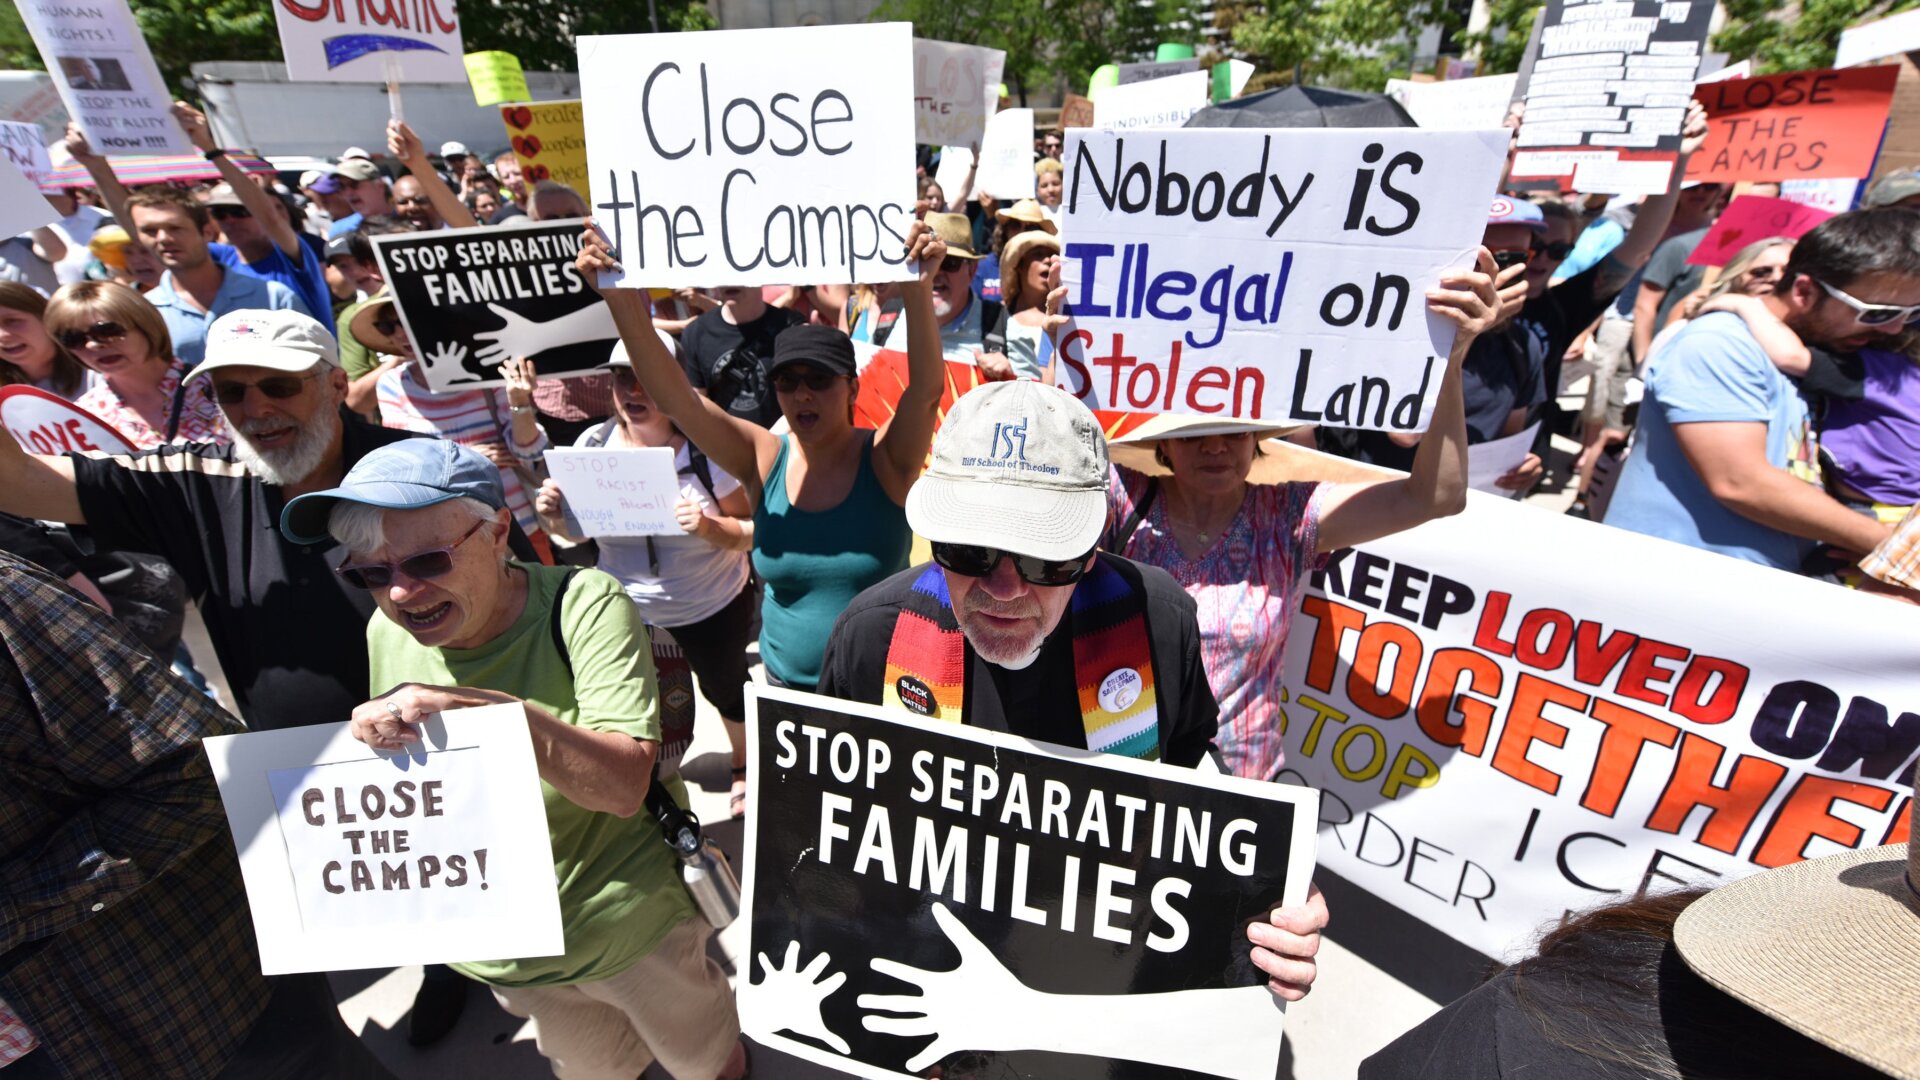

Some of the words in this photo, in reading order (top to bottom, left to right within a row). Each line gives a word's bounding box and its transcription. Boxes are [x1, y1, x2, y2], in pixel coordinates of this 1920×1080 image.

[38, 7, 104, 19] HUMAN
[47, 28, 104, 41] RIGHTS
[76, 94, 112, 109] STOP
[117, 97, 153, 109] THE
[1703, 74, 1840, 111] LOSE
[642, 61, 853, 160] Close
[914, 96, 953, 115] THE
[83, 116, 167, 129] BRUTALITY
[1113, 107, 1198, 129] INDIVISIBLE
[1721, 116, 1803, 144] THE
[101, 136, 141, 148] NOW
[522, 136, 586, 155] Acceptin
[1068, 135, 1316, 238] Nobody
[597, 168, 708, 270] the
[720, 168, 908, 283] Camps
[390, 244, 449, 273] STOP
[423, 261, 584, 307] FAMILIES
[1063, 243, 1294, 348] Illegal
[1319, 271, 1411, 332] on
[1058, 329, 1266, 420] Stolen
[1289, 348, 1435, 430] Land
[12, 418, 101, 456] LOVE
[562, 456, 618, 473] STOP
[977, 458, 1006, 468] School
[1007, 460, 1018, 469] of
[1019, 462, 1061, 476] Theology
[596, 478, 647, 492] RACIST
[565, 509, 614, 521] ENOUGH
[599, 521, 617, 531] IS
[625, 521, 665, 531] ENOUGH
[1106, 670, 1129, 687] CREATE
[1310, 547, 1476, 631] KEEP
[1473, 591, 1750, 724] LOVED
[1750, 680, 1919, 787] ON
[901, 680, 928, 698] BLACK
[1102, 685, 1118, 697] SAFE
[1117, 673, 1136, 689] SPACE
[901, 688, 928, 707] LIVES
[901, 696, 928, 713] MATTER
[302, 780, 444, 827] CLOSE
[775, 719, 892, 789] STOP
[910, 749, 1259, 877] SEPARATING
[342, 829, 411, 855] THE
[322, 848, 489, 895] CAMPS!
[818, 790, 1192, 953] FAMILIES
